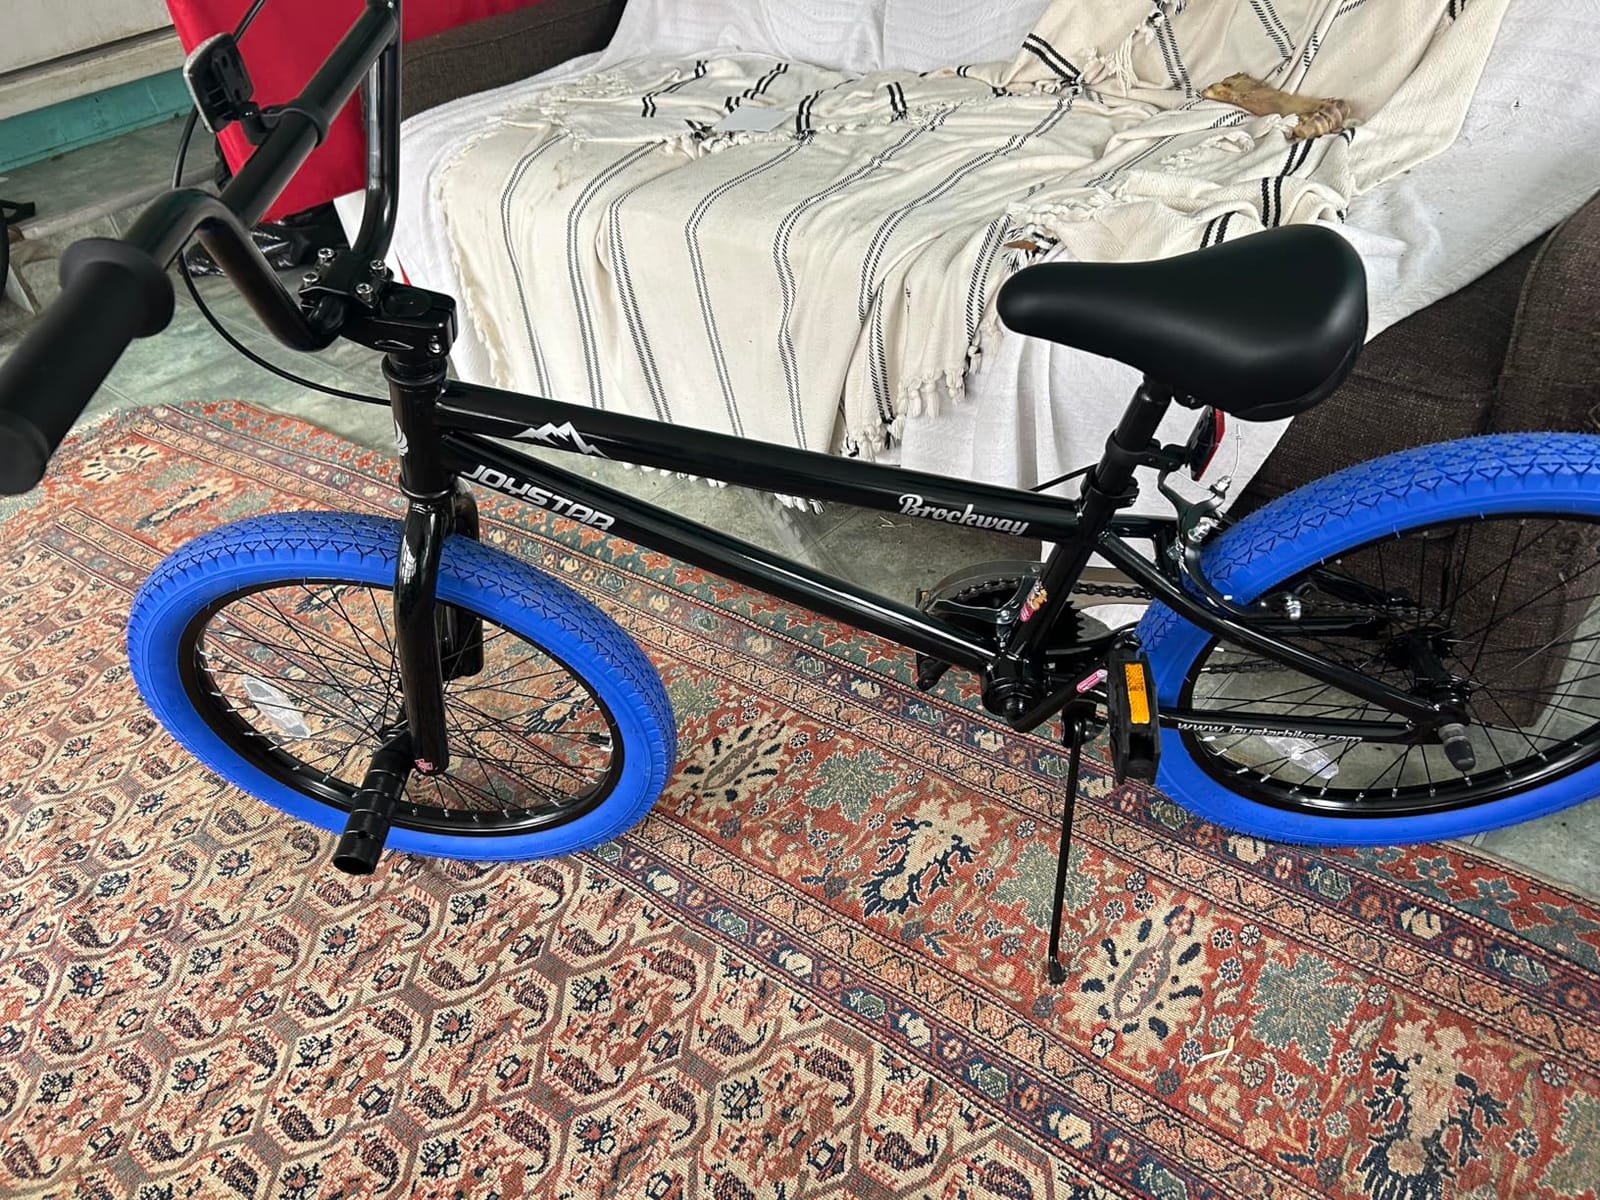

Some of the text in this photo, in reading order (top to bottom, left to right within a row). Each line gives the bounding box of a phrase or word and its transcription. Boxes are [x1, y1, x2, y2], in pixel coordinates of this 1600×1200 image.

[460, 464, 616, 530] JOYSTAR
[898, 493, 1030, 536] Brockway
[1177, 721, 1363, 743] www.joystarbikescom
